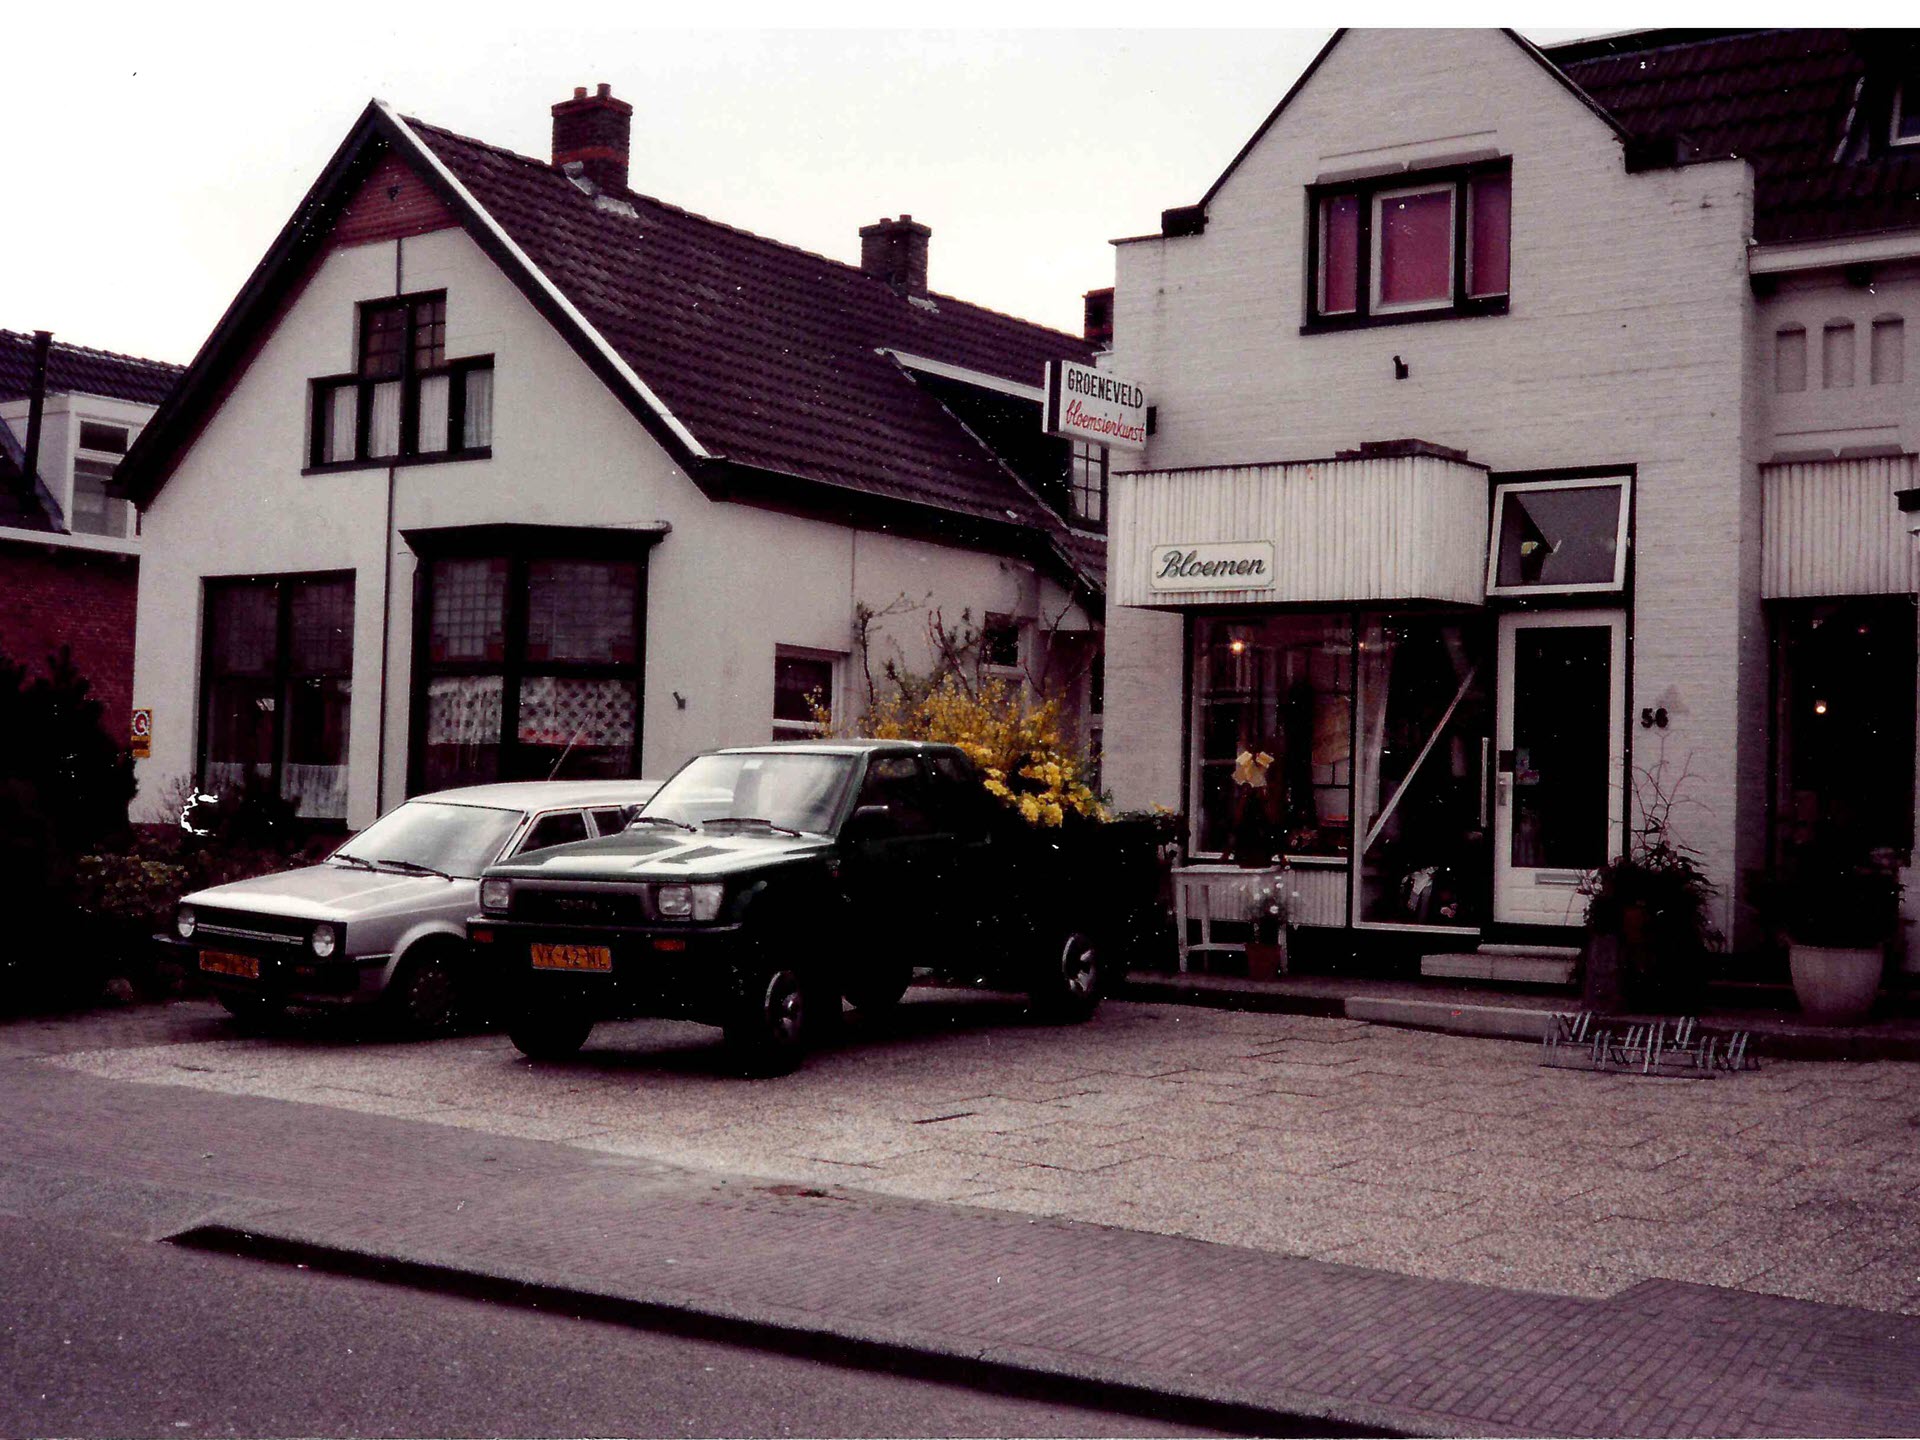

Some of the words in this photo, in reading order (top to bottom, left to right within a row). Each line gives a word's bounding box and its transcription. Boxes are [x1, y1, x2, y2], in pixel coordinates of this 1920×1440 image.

[1067, 367, 1144, 409] GROENEVELD
[1065, 399, 1145, 442] bloemsierkunst
[1156, 549, 1266, 579] Bloemen
